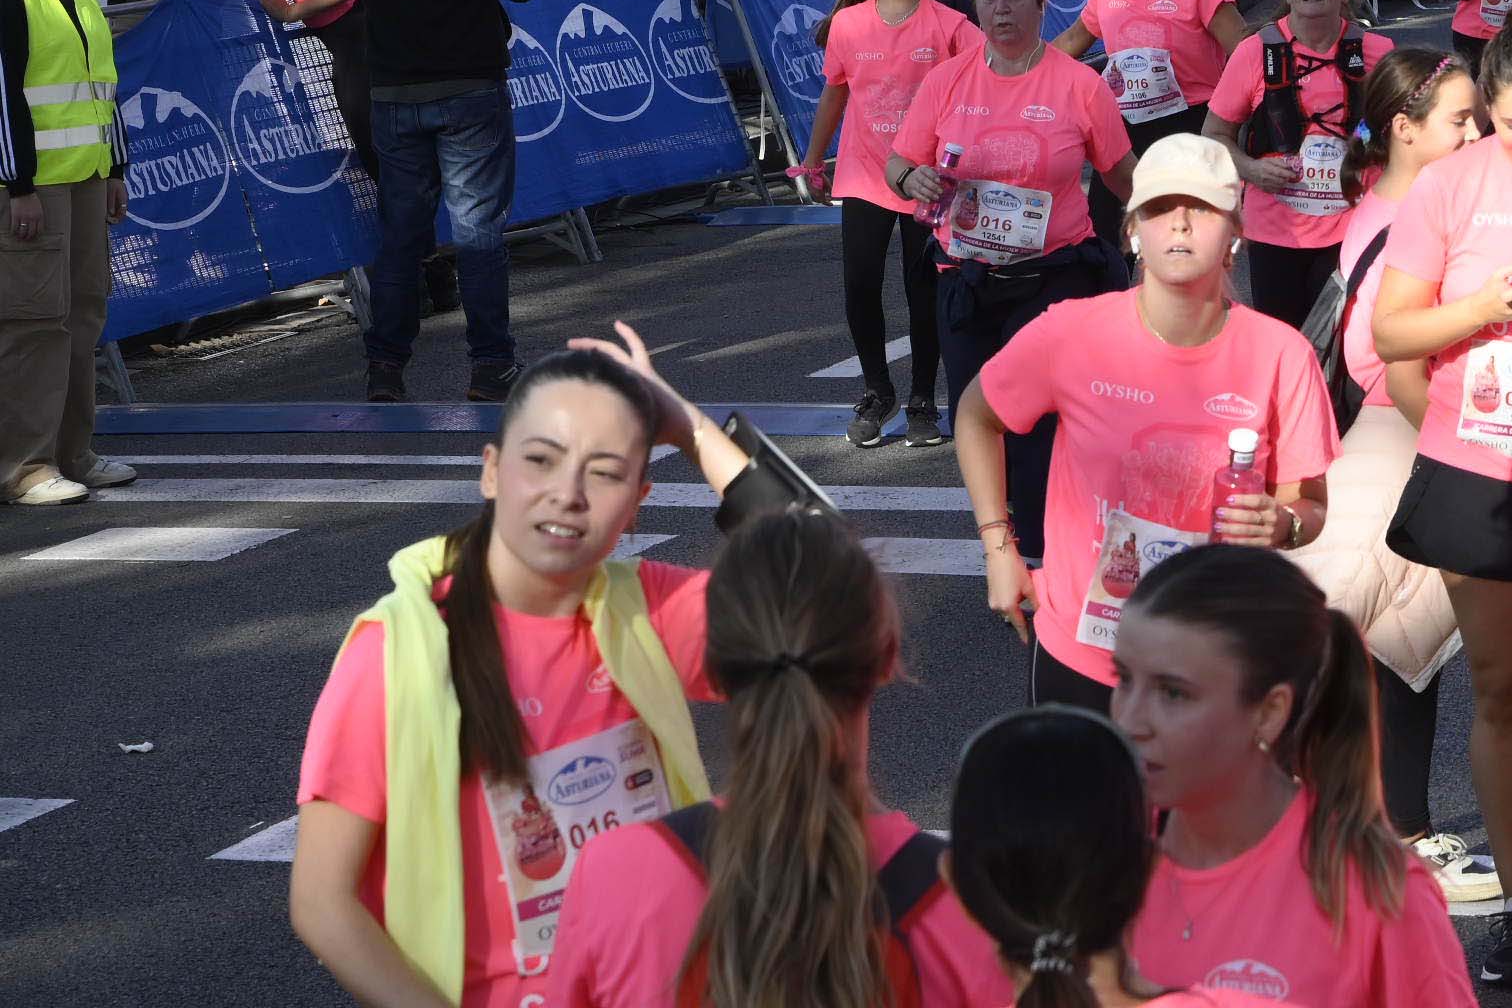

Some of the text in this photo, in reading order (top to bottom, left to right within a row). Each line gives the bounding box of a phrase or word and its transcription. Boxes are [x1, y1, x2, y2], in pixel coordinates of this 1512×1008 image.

[565, 52, 650, 97] ASTURIANA
[1126, 78, 1150, 90] 016
[872, 123, 897, 133] NOS
[1306, 167, 1337, 180] 016
[1310, 182, 1330, 191] 3175
[980, 215, 1013, 232] 016
[983, 231, 1007, 244] 12541
[1091, 379, 1155, 404] OYSHO
[1101, 606, 1121, 620] CAR
